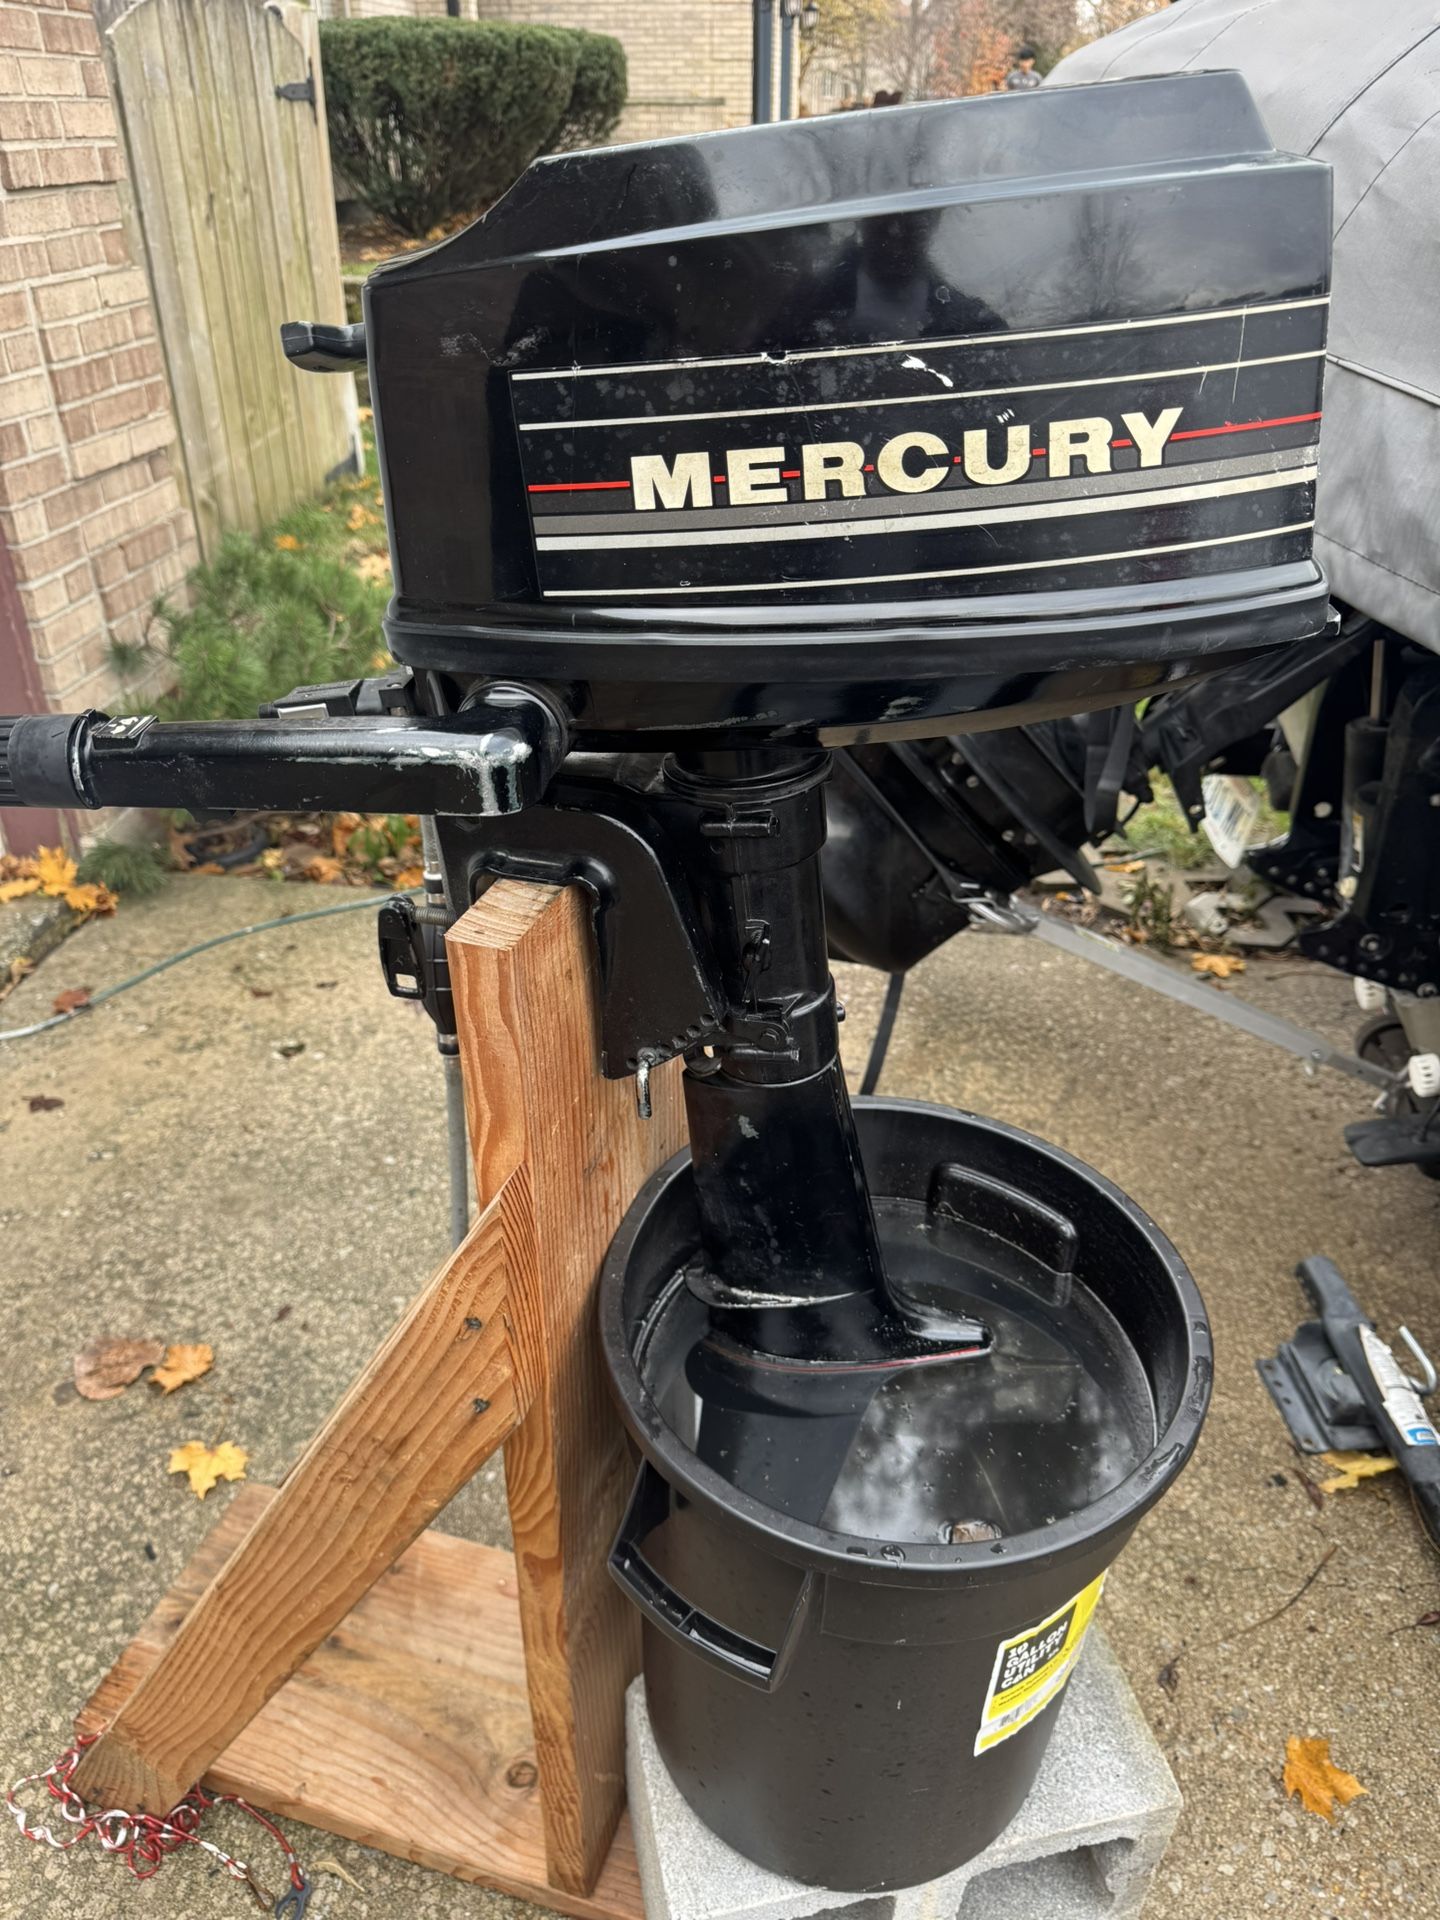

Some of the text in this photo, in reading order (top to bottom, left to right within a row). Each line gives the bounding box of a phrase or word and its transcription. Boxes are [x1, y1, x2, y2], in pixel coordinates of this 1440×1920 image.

[630, 406, 1184, 511] MERCURY
[1003, 1632, 1064, 1678] UTILITY
[1006, 1620, 1068, 1668] GALLON
[1008, 1642, 1029, 1659] 10
[1001, 1663, 1035, 1689] CAN
